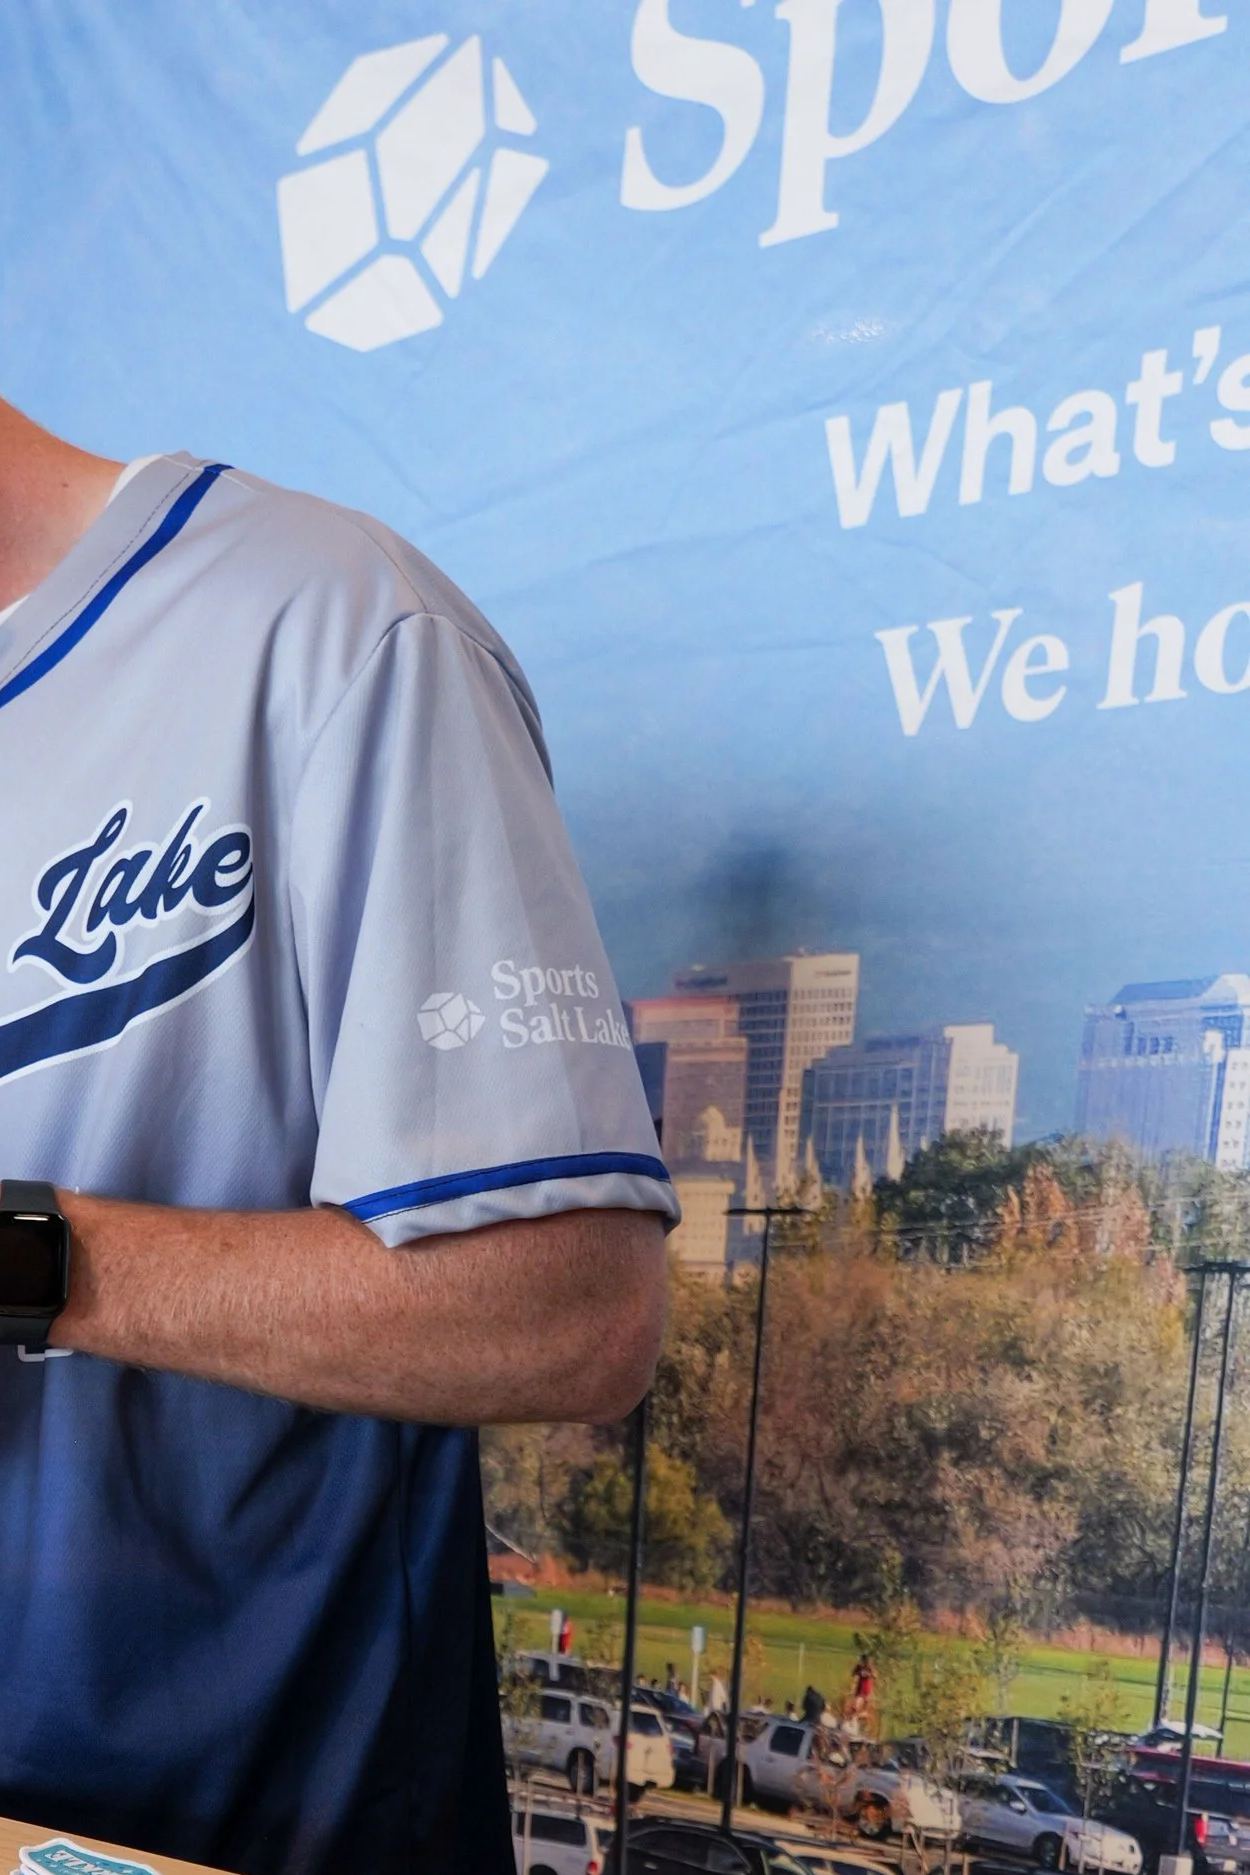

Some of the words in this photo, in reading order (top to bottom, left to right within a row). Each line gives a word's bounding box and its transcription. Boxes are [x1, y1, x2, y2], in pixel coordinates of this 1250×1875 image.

[875, 609, 1069, 737] We
[13, 802, 253, 985] Lake
[491, 960, 599, 1007] Sports
[500, 1003, 576, 1048] Salt
[574, 1006, 632, 1051] Lake
